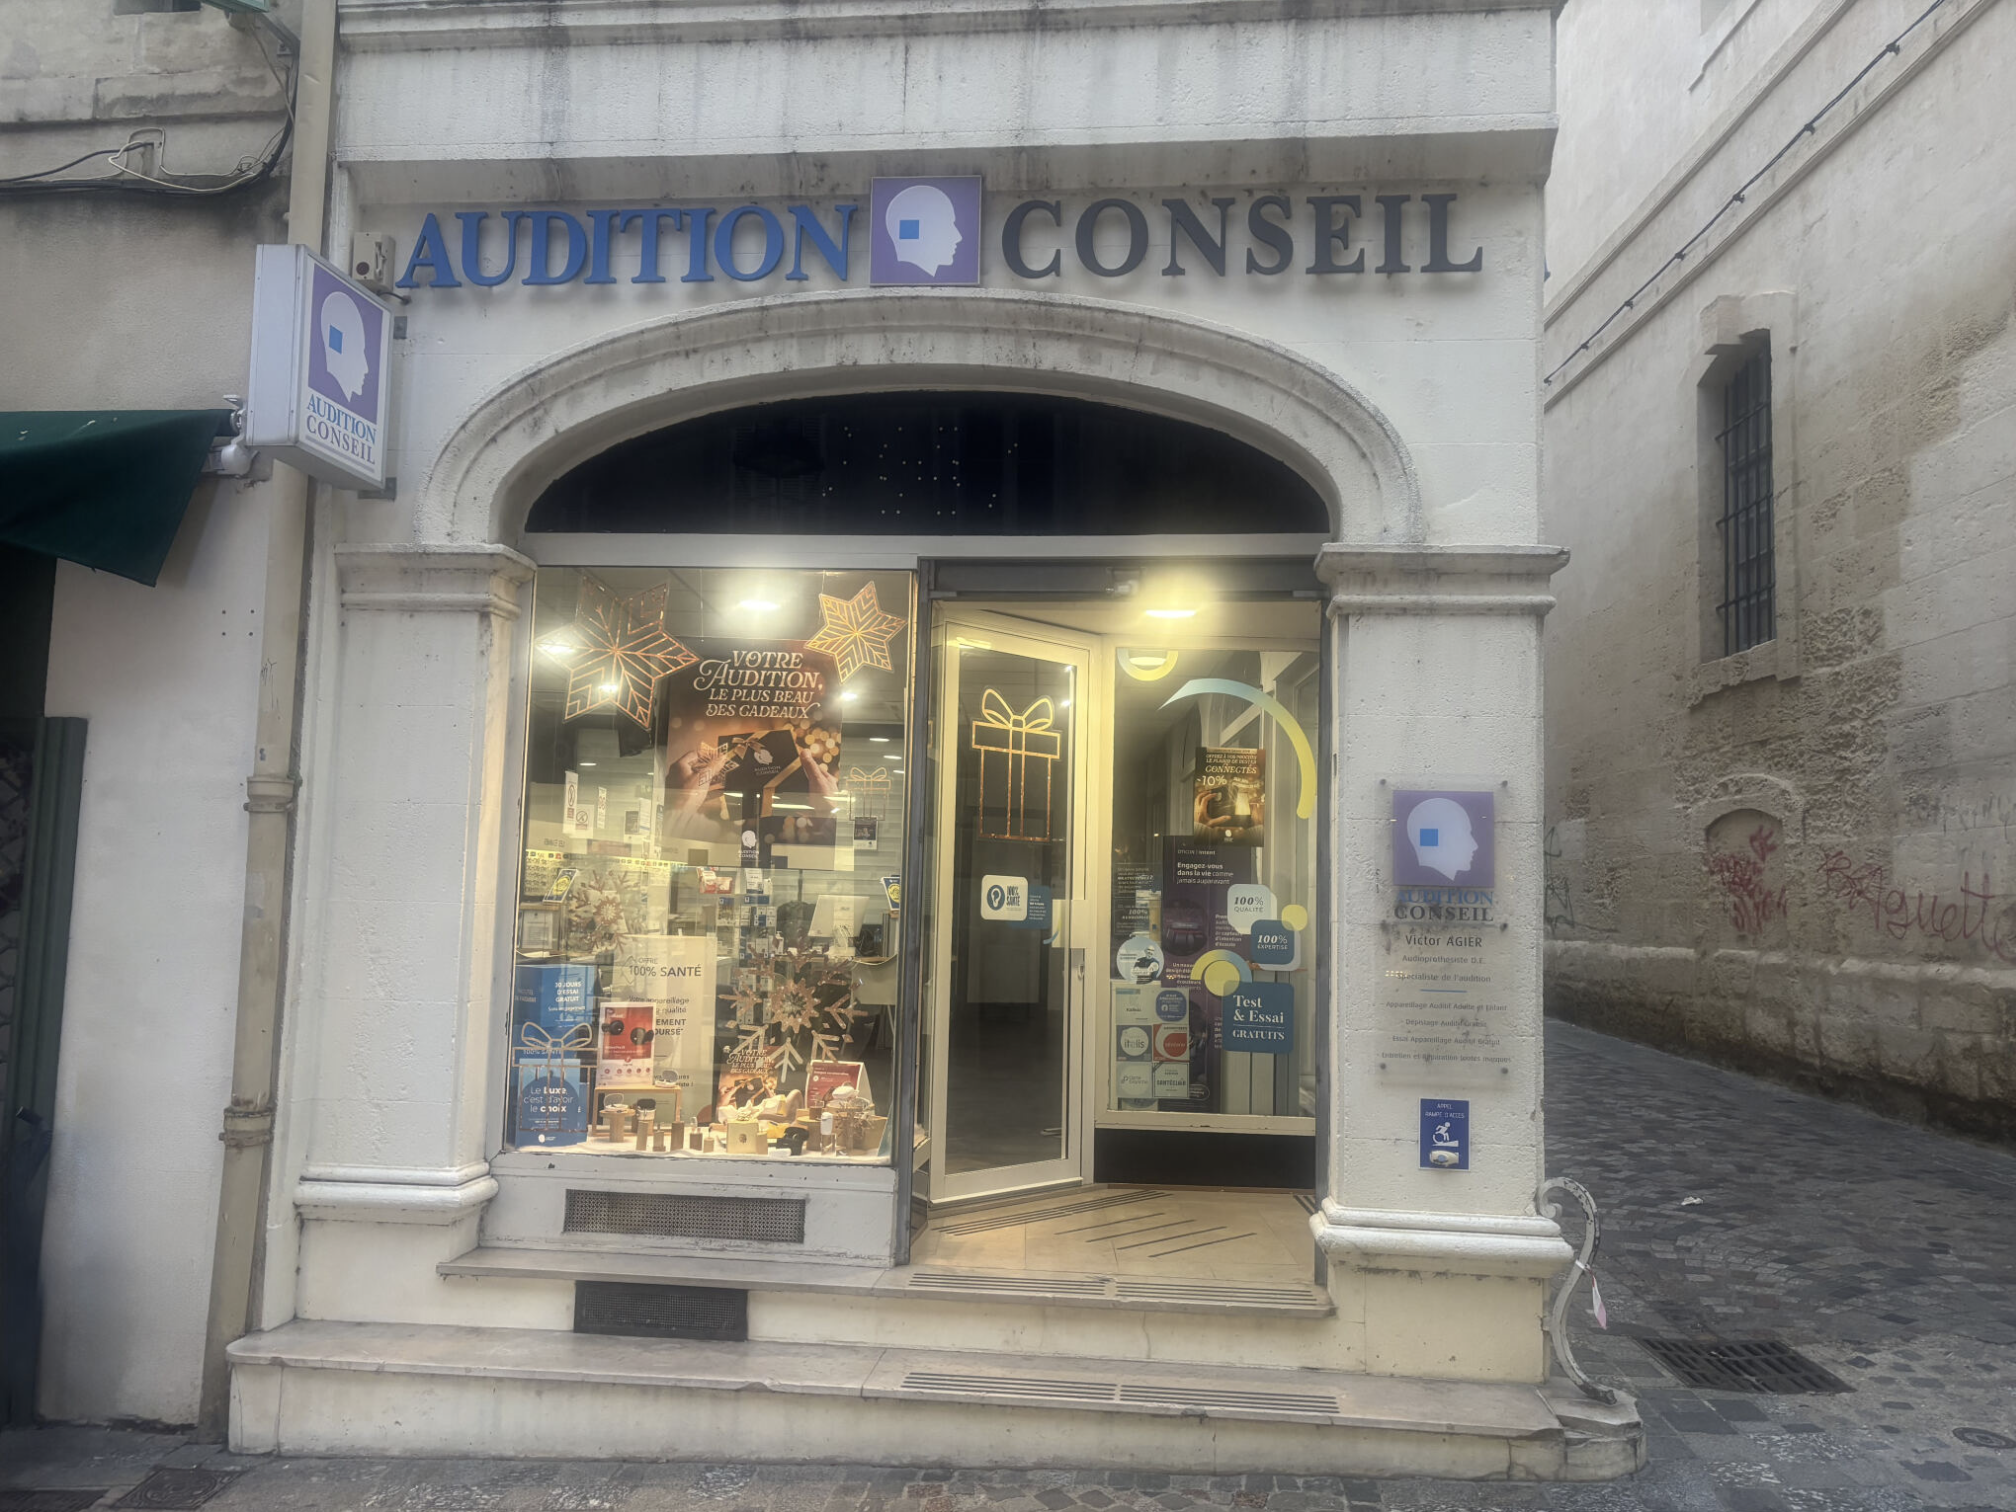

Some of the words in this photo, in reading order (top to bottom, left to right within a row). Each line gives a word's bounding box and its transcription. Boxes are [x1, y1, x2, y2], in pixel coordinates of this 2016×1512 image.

[396, 205, 857, 288] AUDITION
[1001, 194, 1483, 280] CONSEIL
[306, 393, 376, 446] AUDITION
[306, 415, 376, 465] CONSEIL
[732, 650, 804, 669] VOTRE
[693, 659, 823, 691] AUDITION,
[708, 688, 729, 700] LE
[731, 689, 770, 702] PLUS
[774, 691, 814, 703] BEAU
[706, 704, 736, 716] DES
[739, 702, 821, 718] CADEAUX
[1178, 862, 1223, 870] Engagez-vous
[1234, 896, 1264, 906] 100%
[1396, 890, 1494, 905] AUDITION
[1394, 905, 1494, 921] CONSEIL
[1258, 935, 1288, 944] 100%
[1406, 935, 1440, 946] Victor
[1446, 936, 1482, 948] AGIER
[630, 965, 657, 977] 100%
[660, 964, 702, 977] SANTÉ
[1233, 995, 1262, 1008] Test
[1234, 1009, 1245, 1021] &
[1250, 1010, 1284, 1023] Essai
[1232, 1030, 1284, 1040] GRATUITS
[524, 1095, 543, 1104] c'est
[530, 1104, 538, 1112] le
